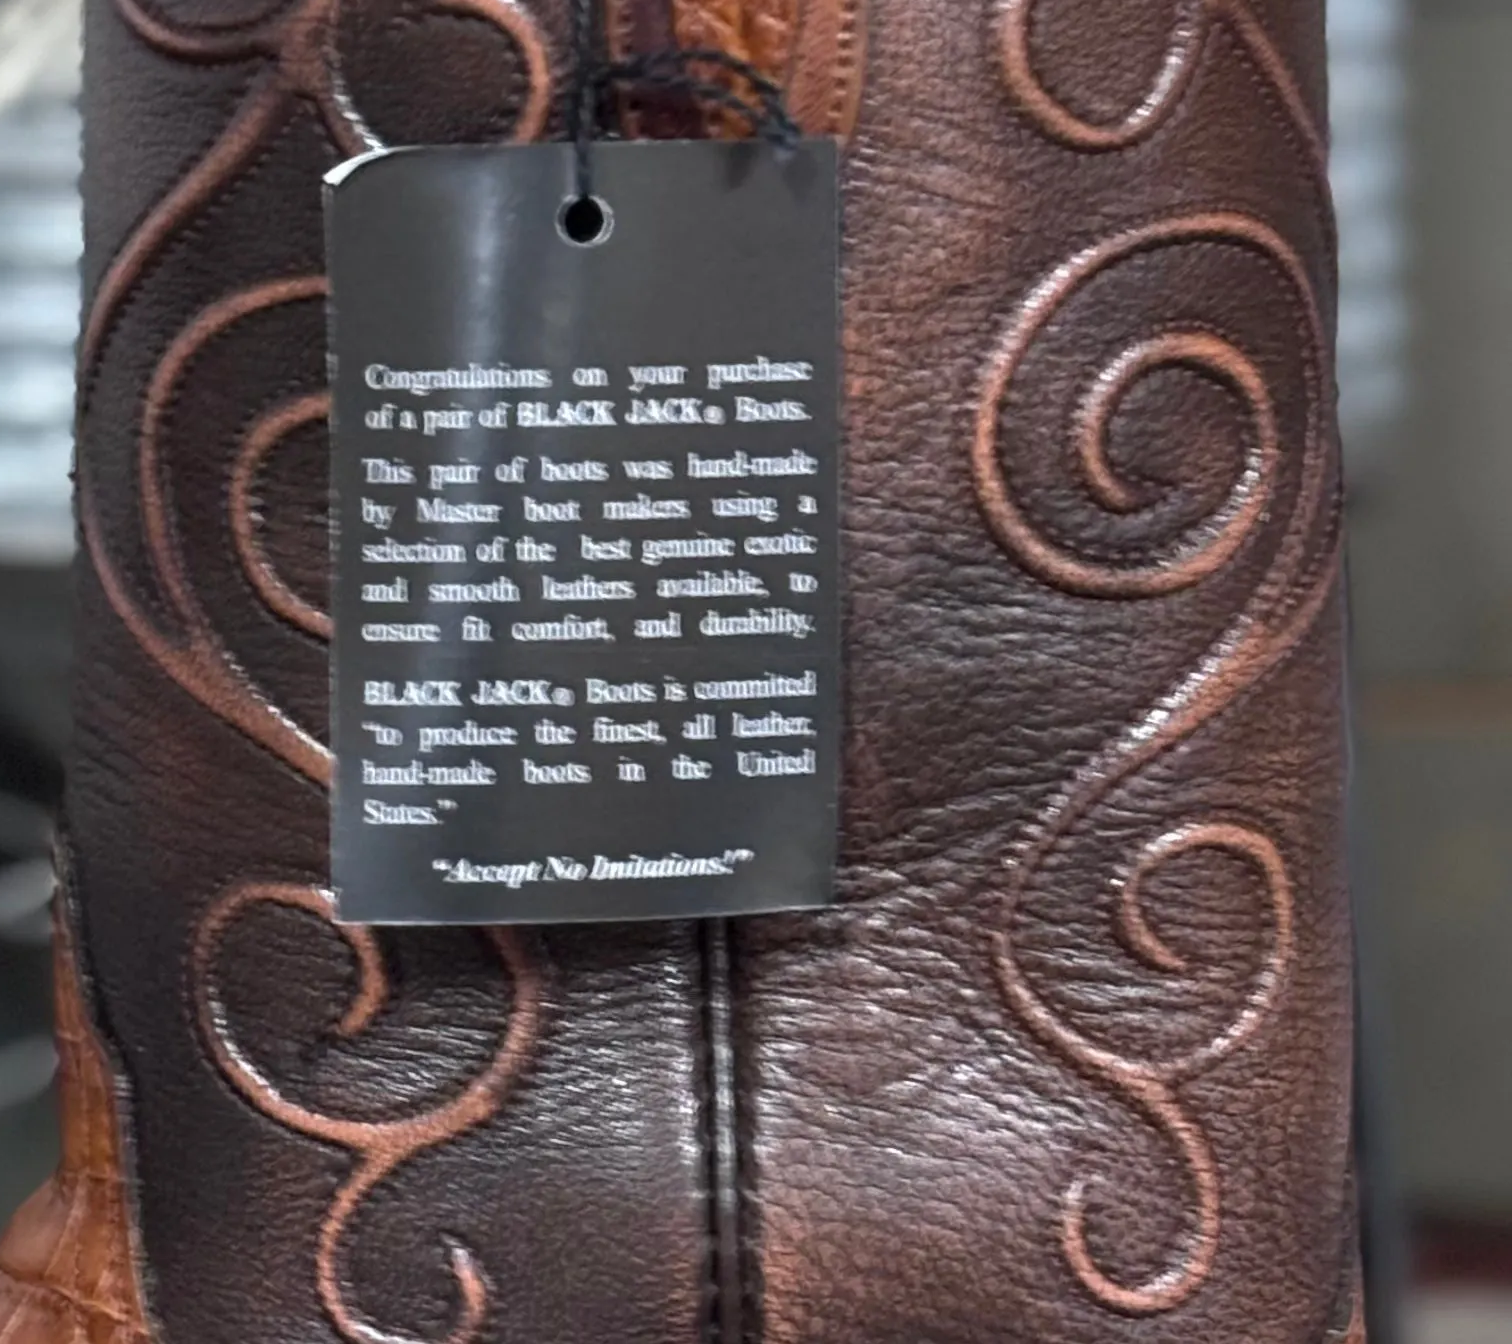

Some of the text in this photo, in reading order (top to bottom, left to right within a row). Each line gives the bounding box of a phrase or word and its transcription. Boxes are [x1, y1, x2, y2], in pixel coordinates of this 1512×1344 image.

[364, 356, 813, 395] Congratulations on your purchase
[365, 403, 395, 429] of
[400, 411, 417, 429] a
[423, 403, 472, 435] pair
[478, 402, 508, 428] of
[517, 401, 616, 426] BLACK
[361, 448, 818, 490] This pair of boots was hand-made
[361, 491, 818, 528] by Master boot makers using a
[362, 528, 818, 566] selection of the best genuine exotic
[361, 576, 408, 602] and
[429, 576, 520, 602] smooth
[788, 572, 818, 593] to
[361, 623, 441, 642] ensure
[511, 614, 616, 643] comfort,
[634, 611, 682, 638] and
[363, 680, 462, 706] BLACK
[586, 678, 656, 704] Boots
[663, 676, 687, 701] is
[419, 720, 518, 752] produce
[534, 719, 577, 745] the
[682, 714, 717, 740] all
[362, 749, 816, 785] hand-made boots in the United
[543, 856, 588, 881] No
